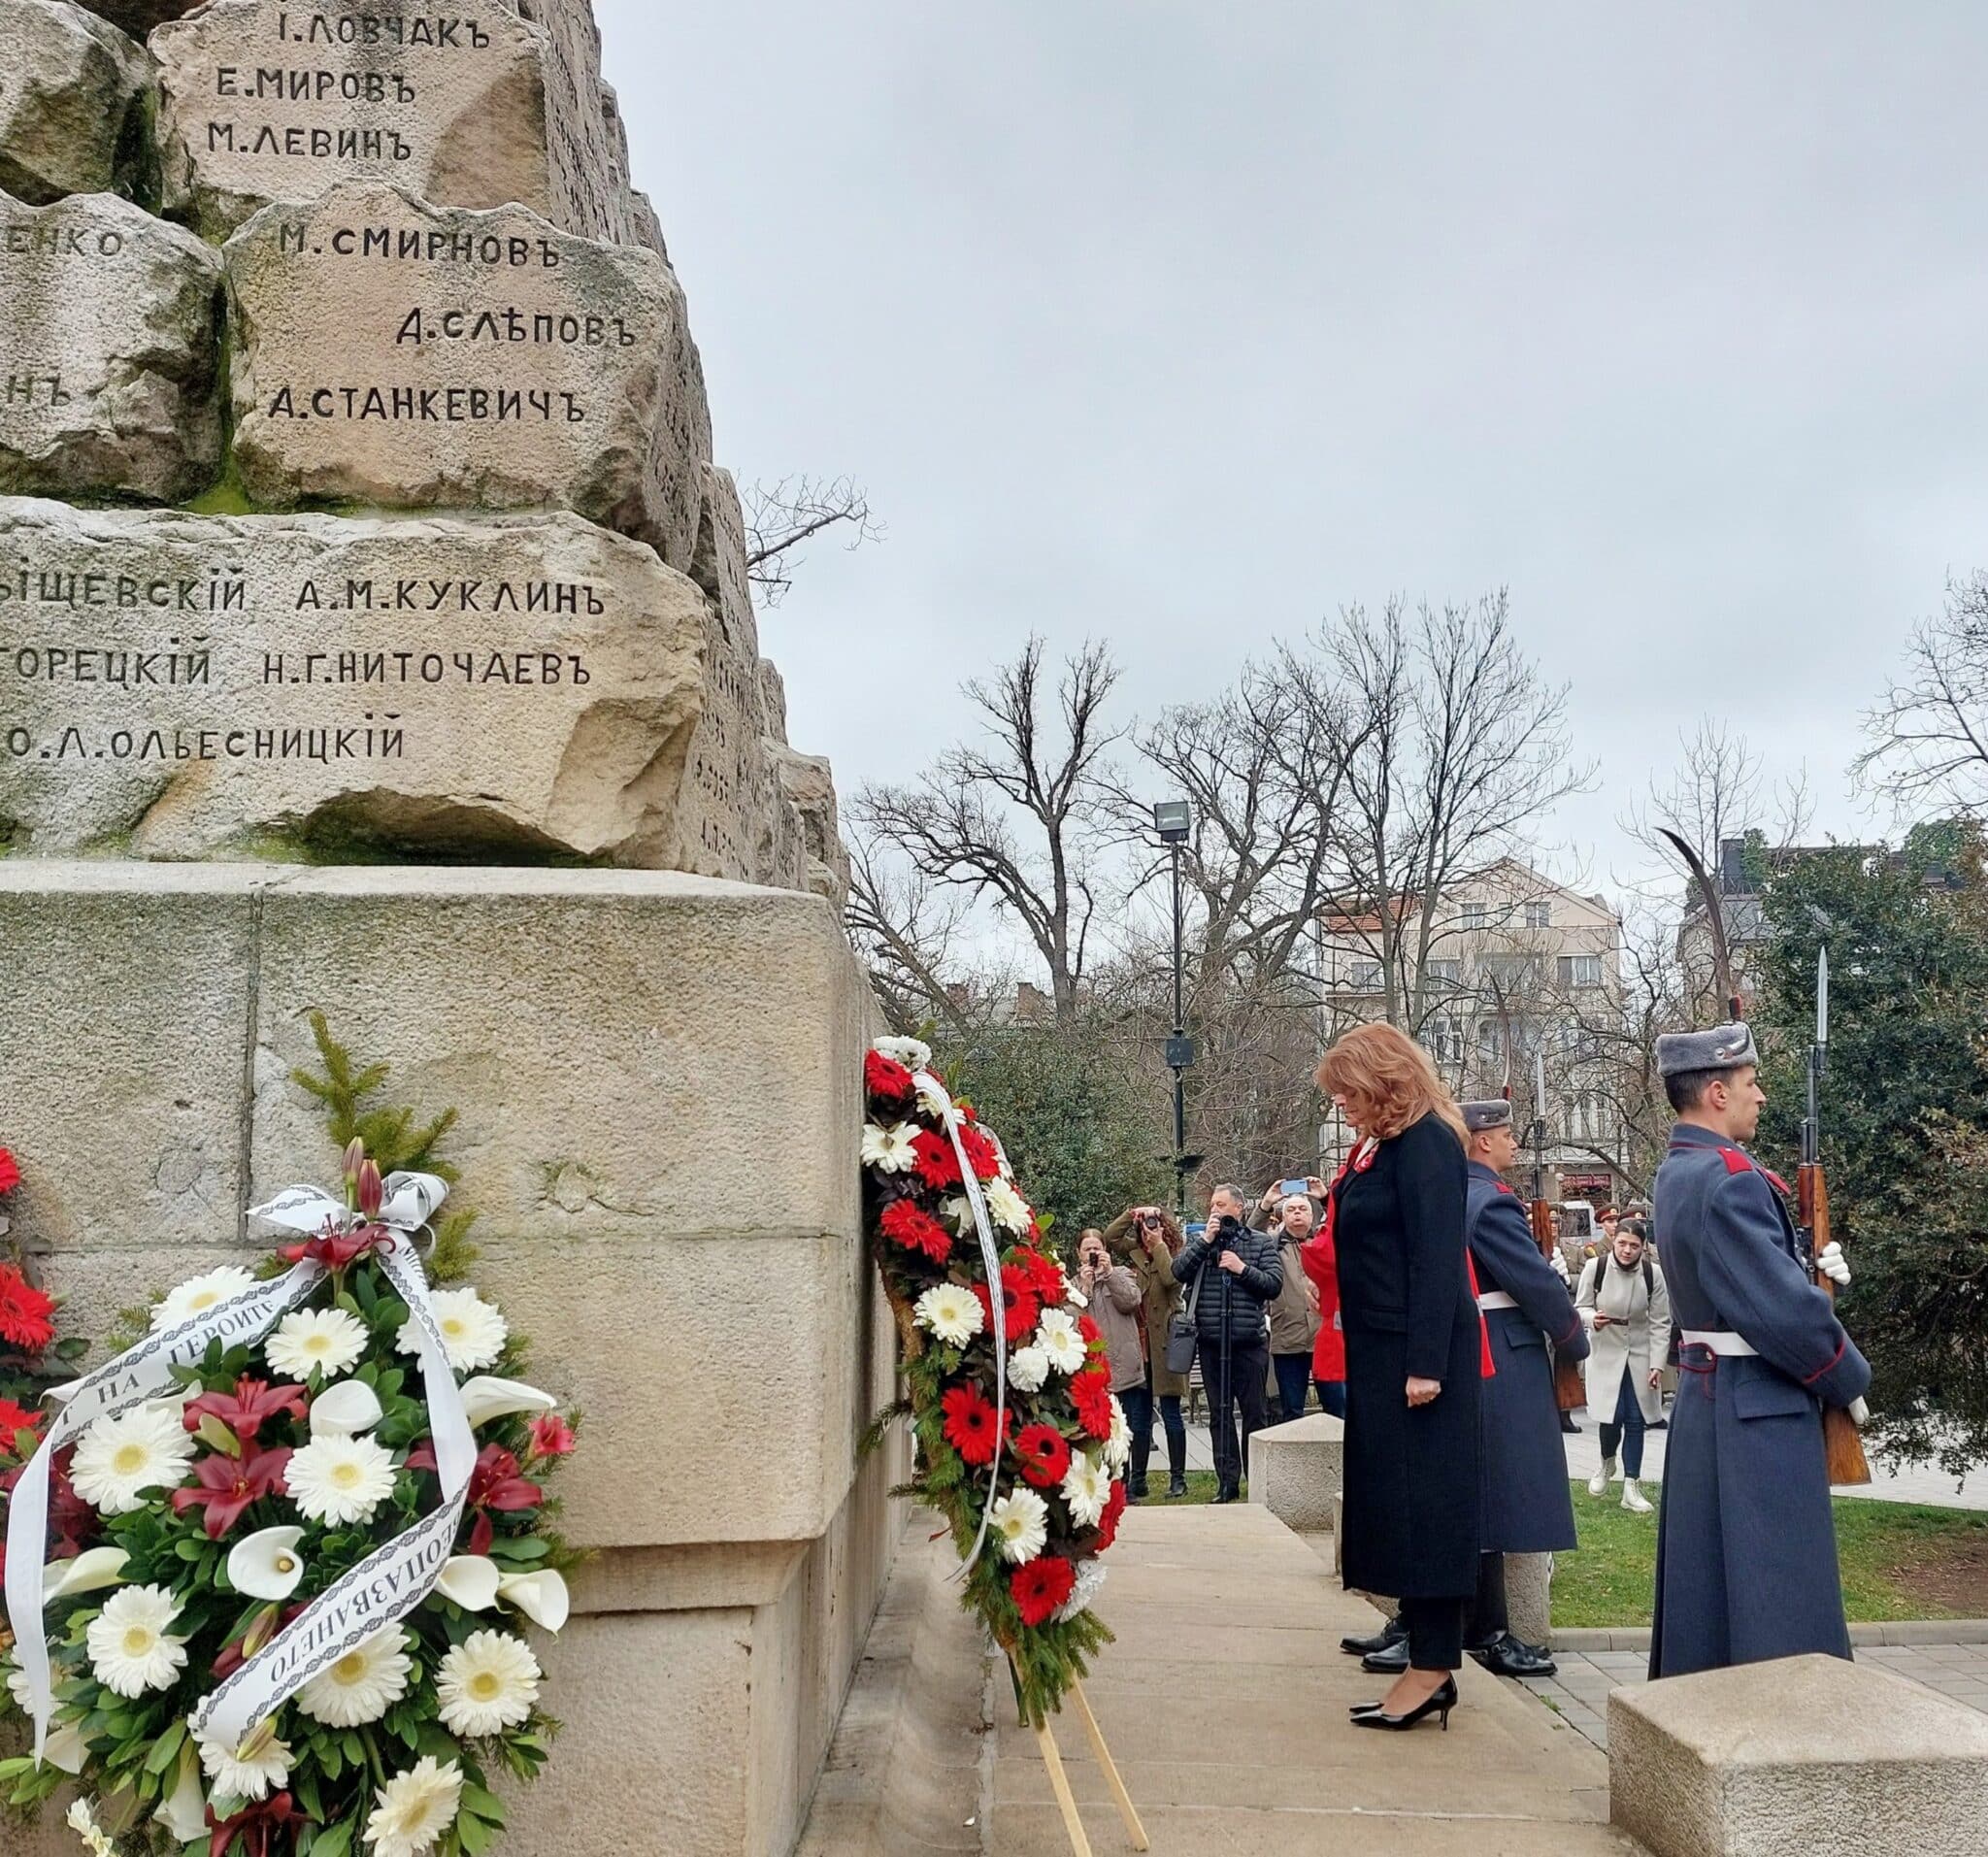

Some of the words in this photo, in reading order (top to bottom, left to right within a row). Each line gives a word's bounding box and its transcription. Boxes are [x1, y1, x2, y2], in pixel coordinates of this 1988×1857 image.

[216, 67, 415, 103] Е.МИРОВЪ
[208, 122, 412, 160] М.ЛЕВИНЪ
[268, 387, 585, 422] А.СТАНКЕВИЧЪ
[0, 636, 210, 690] ОРЕЦКІЙ
[97, 1373, 141, 1405] НА
